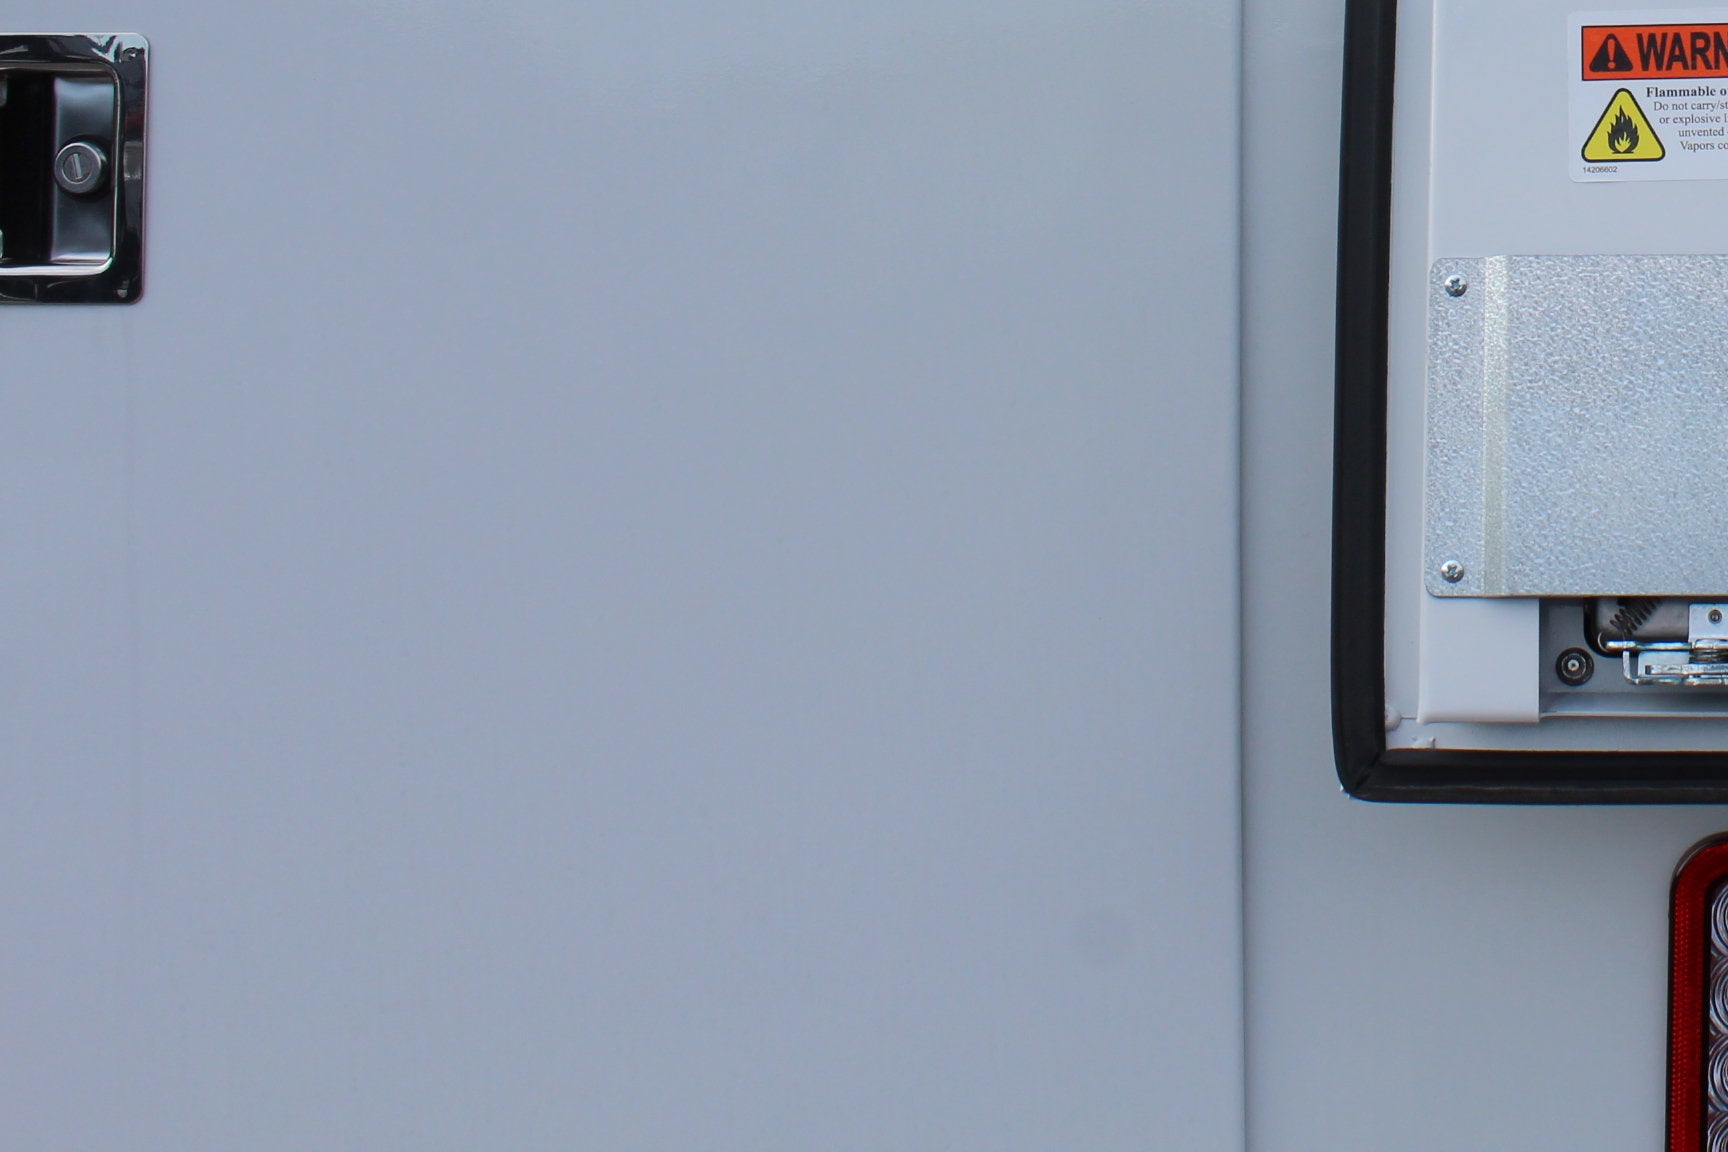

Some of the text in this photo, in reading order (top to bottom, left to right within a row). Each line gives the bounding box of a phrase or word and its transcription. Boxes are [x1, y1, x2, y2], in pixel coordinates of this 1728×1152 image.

[1646, 86, 1716, 98] Flammable
[1653, 101, 1669, 111] Do
[1672, 102, 1688, 110] not
[1659, 116, 1670, 124] or
[1672, 113, 1721, 126] explosive
[1678, 127, 1724, 138] unvented
[1680, 140, 1715, 152] Vapors
[1583, 166, 1618, 174] 14206602
